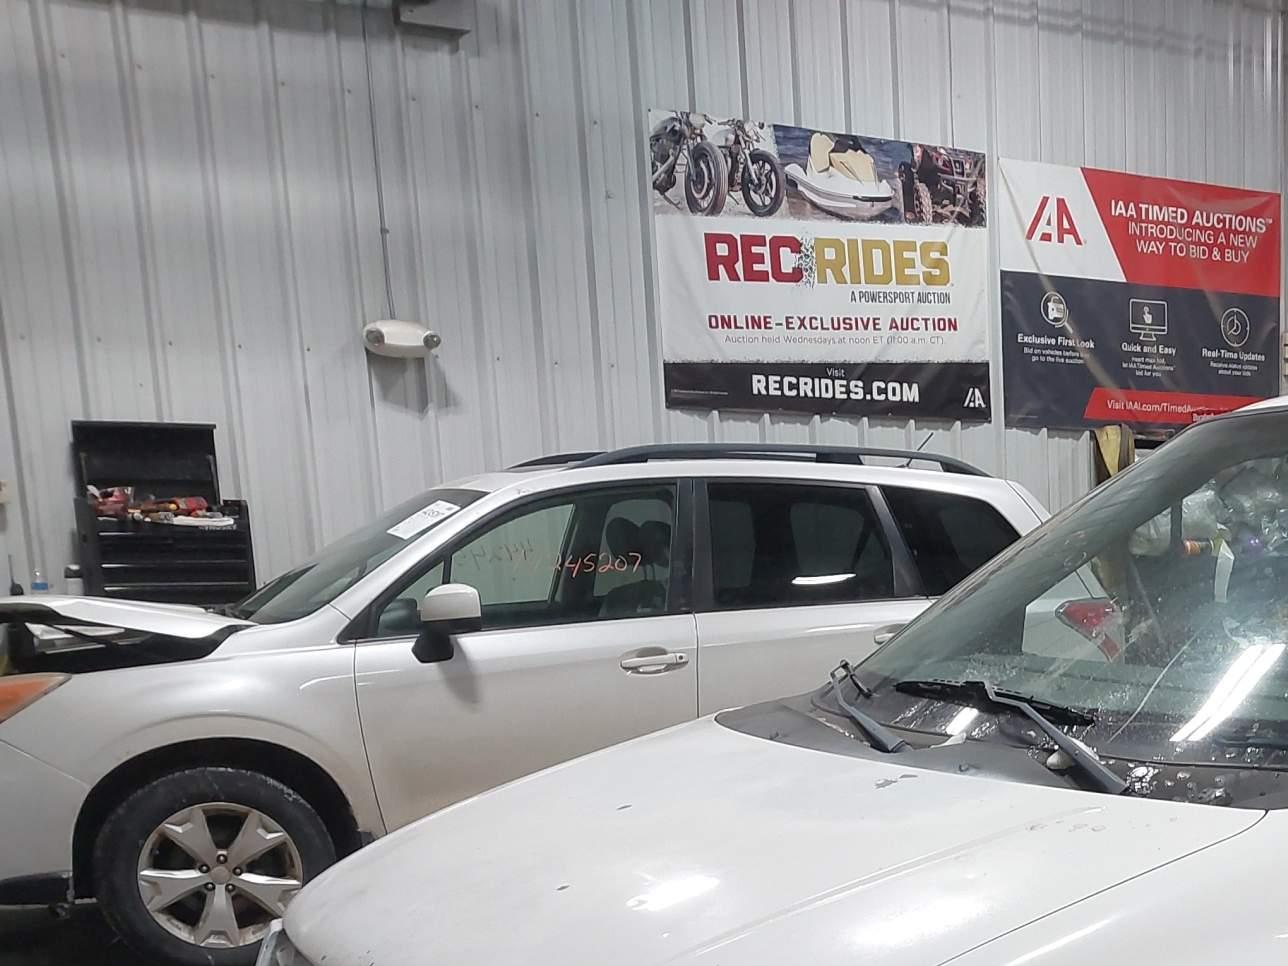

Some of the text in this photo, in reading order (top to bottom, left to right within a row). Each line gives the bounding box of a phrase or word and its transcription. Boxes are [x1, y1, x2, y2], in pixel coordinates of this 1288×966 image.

[1111, 199, 1137, 218] IAA
[1139, 203, 1188, 224] TIMED
[1128, 221, 1258, 248] INTRODUCING A NEW
[1136, 240, 1250, 263] WAY TO BID & BUY
[704, 232, 951, 287] REC RIDES
[849, 290, 951, 305] A POWERSPORT AUCTION
[707, 314, 959, 332] ONLINE-EXCLUSIVE AUCTION
[724, 334, 760, 345] Auction
[761, 335, 781, 345] held
[848, 336, 871, 345] noon
[872, 336, 884, 345] ET
[1017, 332, 1056, 345] Exclusive
[1057, 335, 1076, 347] First
[1121, 342, 1177, 357] Quick and Easy
[1201, 347, 1266, 362] Real-Time Updates
[826, 367, 846, 377] Visit
[751, 373, 920, 403] RECRIDES.COM
[1107, 399, 1124, 410] Visit
